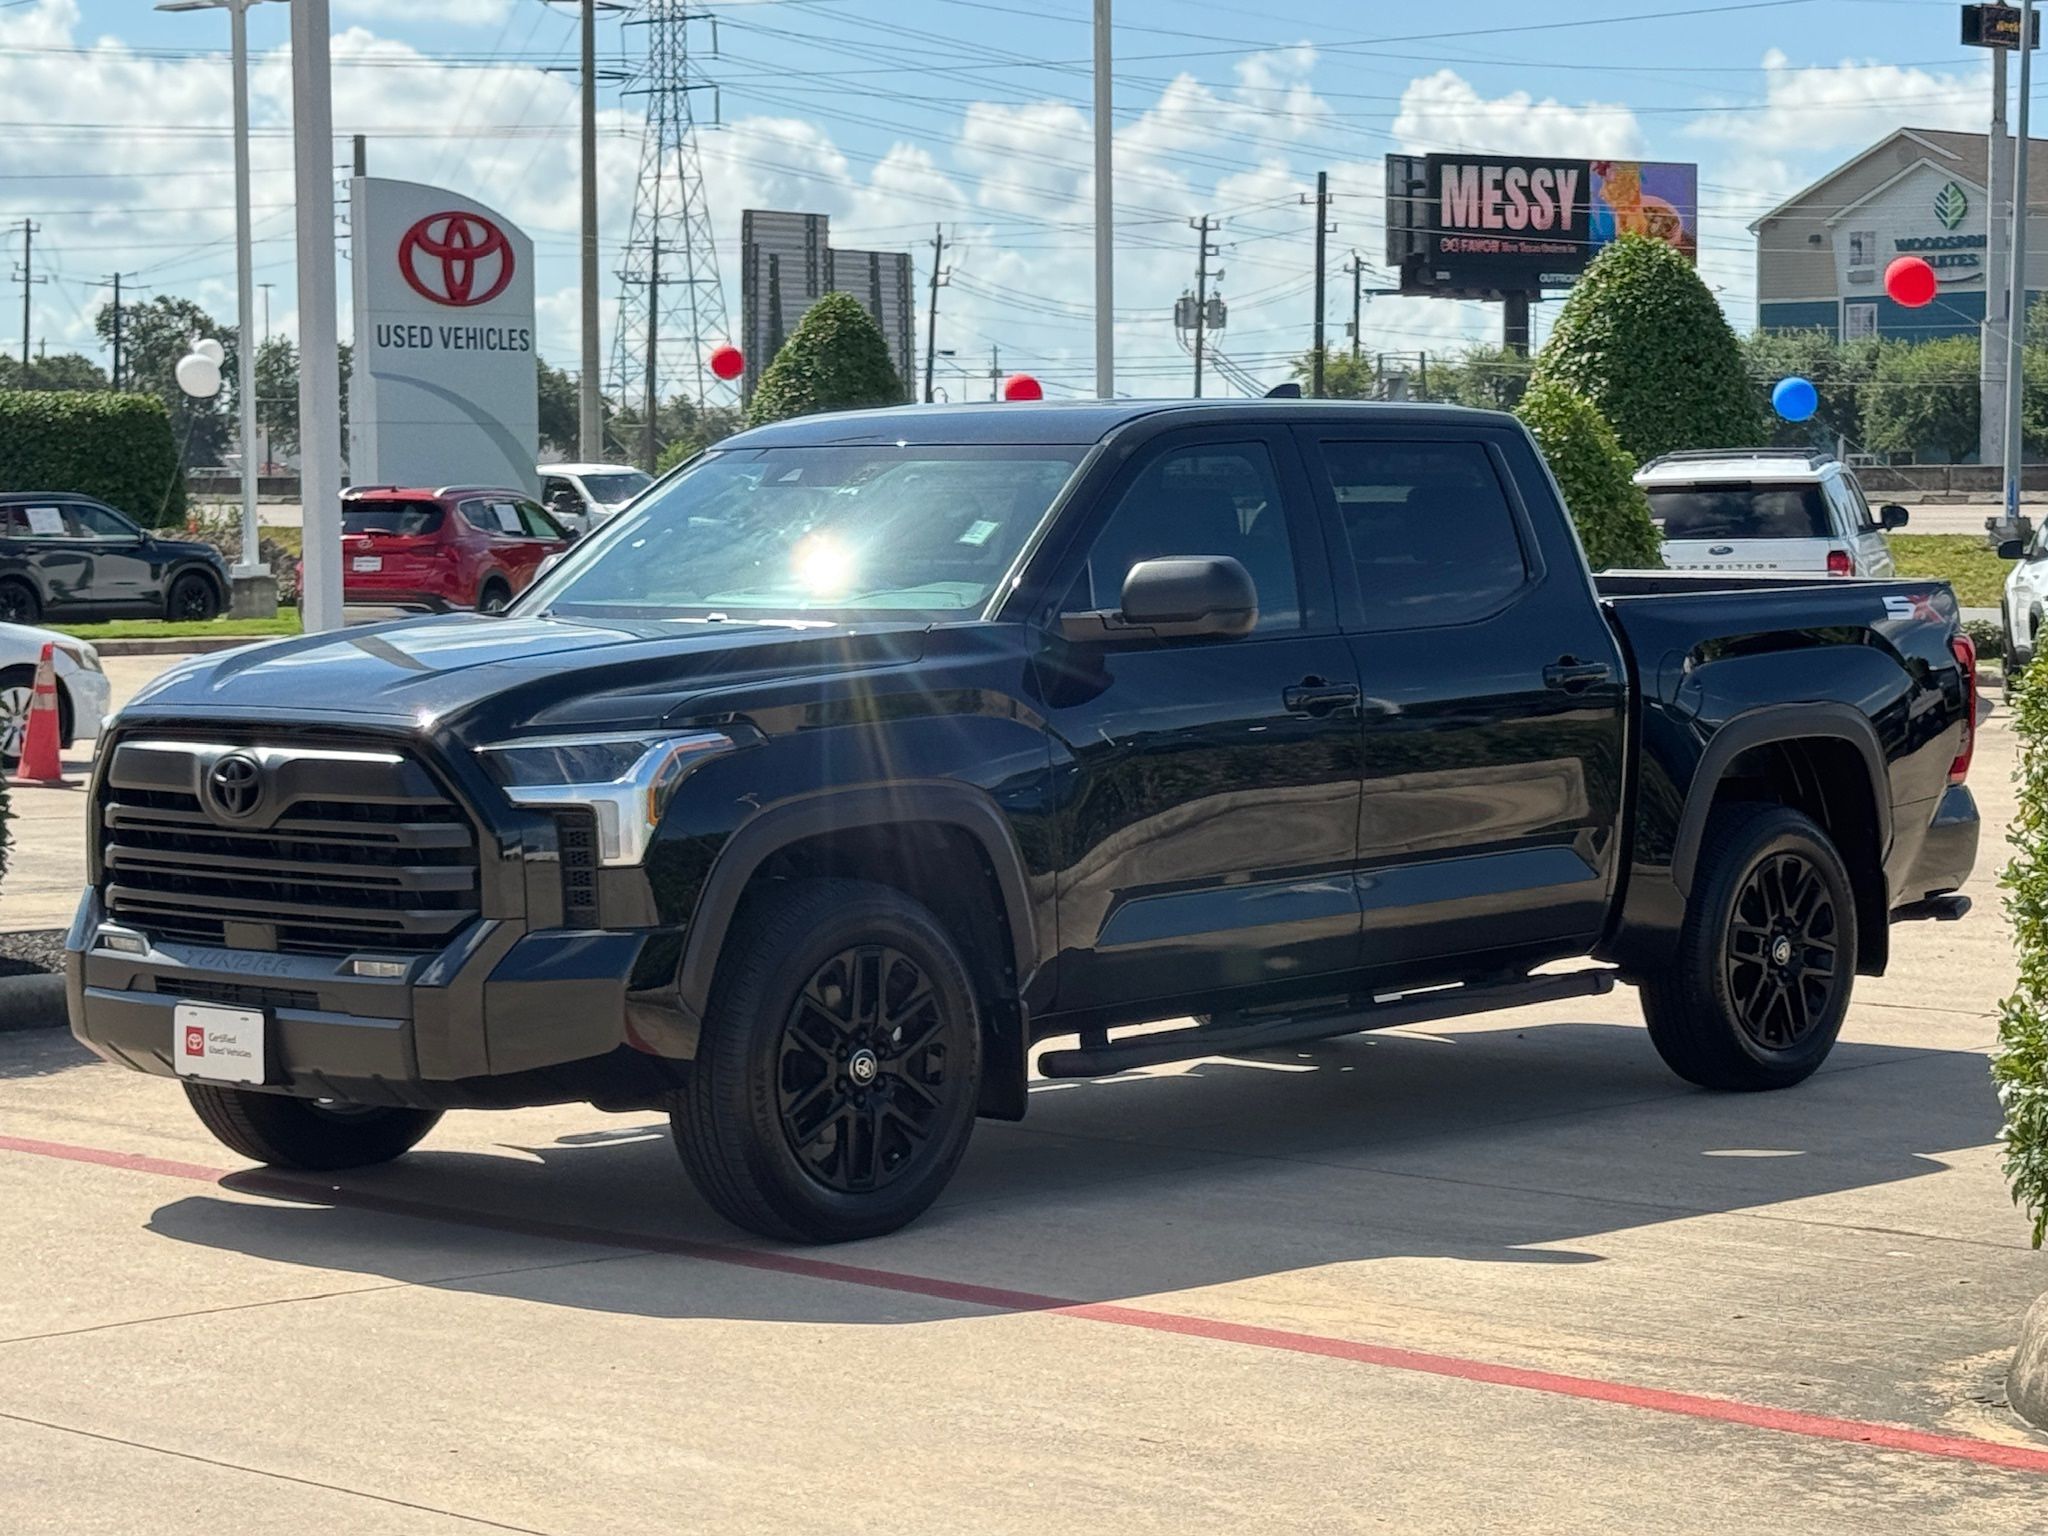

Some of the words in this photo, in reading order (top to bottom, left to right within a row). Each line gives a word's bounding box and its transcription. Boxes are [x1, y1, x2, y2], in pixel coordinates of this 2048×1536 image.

[1441, 164, 1579, 231] MESSY
[1894, 234, 1987, 251] WOODSPRI
[377, 324, 433, 349] USED
[439, 326, 530, 352] VEHICLES
[185, 950, 294, 974] TUNDRA
[208, 1032, 237, 1044] Certified
